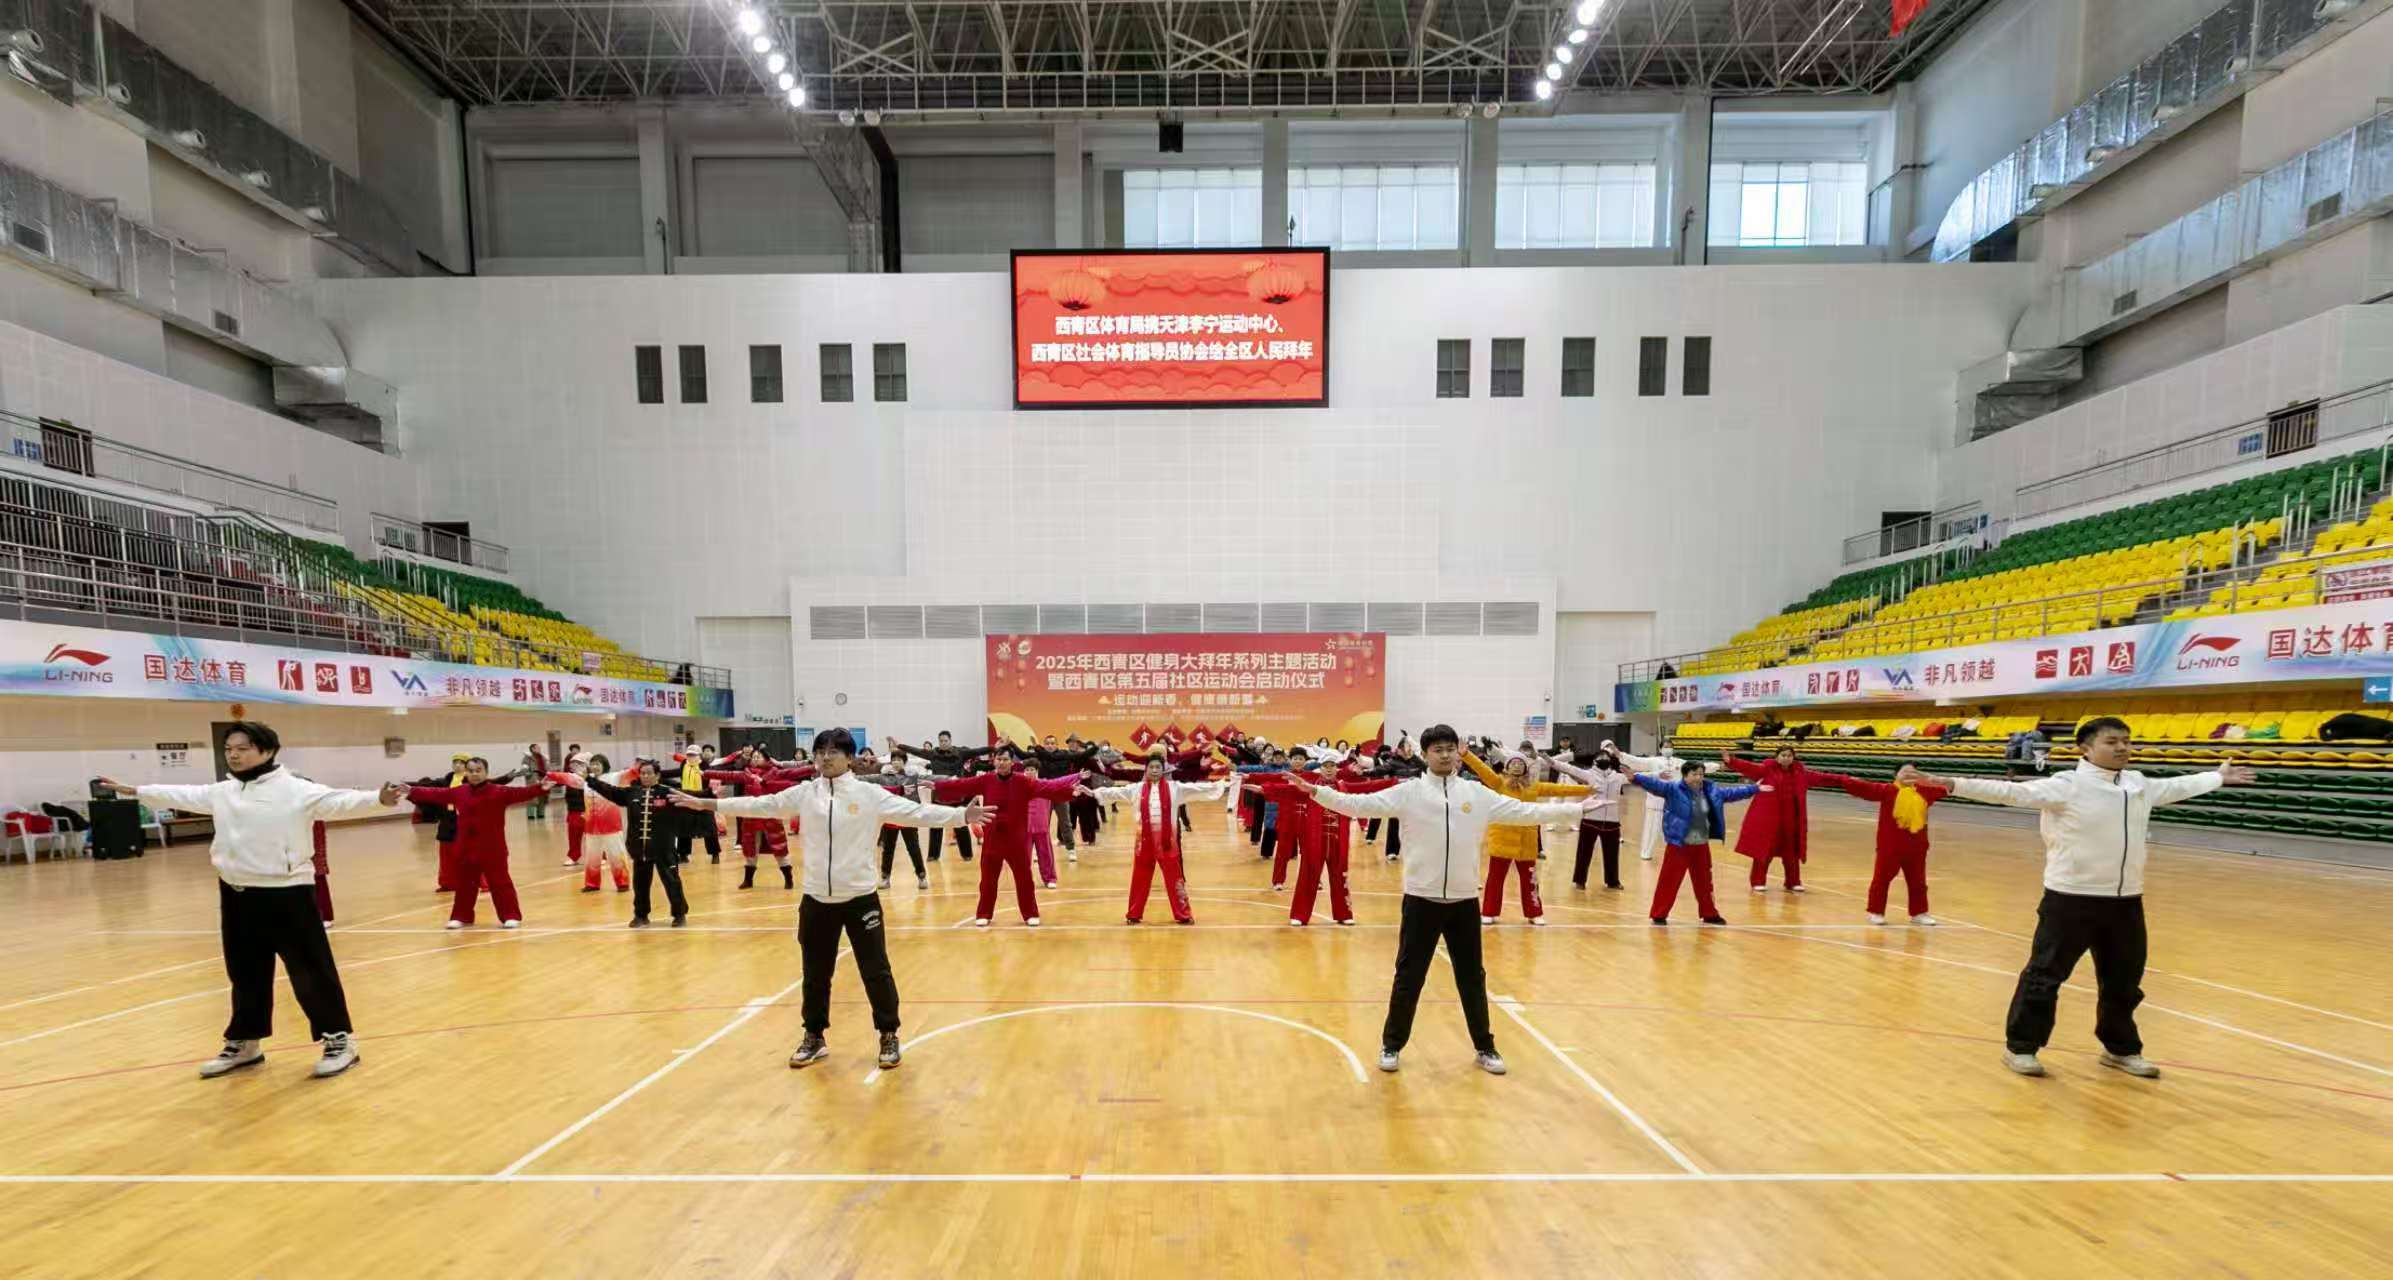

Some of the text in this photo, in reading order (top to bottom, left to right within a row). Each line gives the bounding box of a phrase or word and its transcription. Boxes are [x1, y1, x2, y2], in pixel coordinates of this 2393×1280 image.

[1031, 340, 1313, 361] 西青区社会体育指导员协会给全区人民拜年
[1035, 652, 1337, 670] 2025年西青区健身大拜年系列主题活动
[2177, 655, 2240, 671] LI-NING
[44, 671, 113, 683] LI-NING
[144, 654, 247, 688] 国达体育
[1925, 658, 1995, 685] 非凡领越
[448, 678, 500, 697] 非凡领越
[1048, 672, 1325, 690] 暨西青区第五届社区运动会启动仪式
